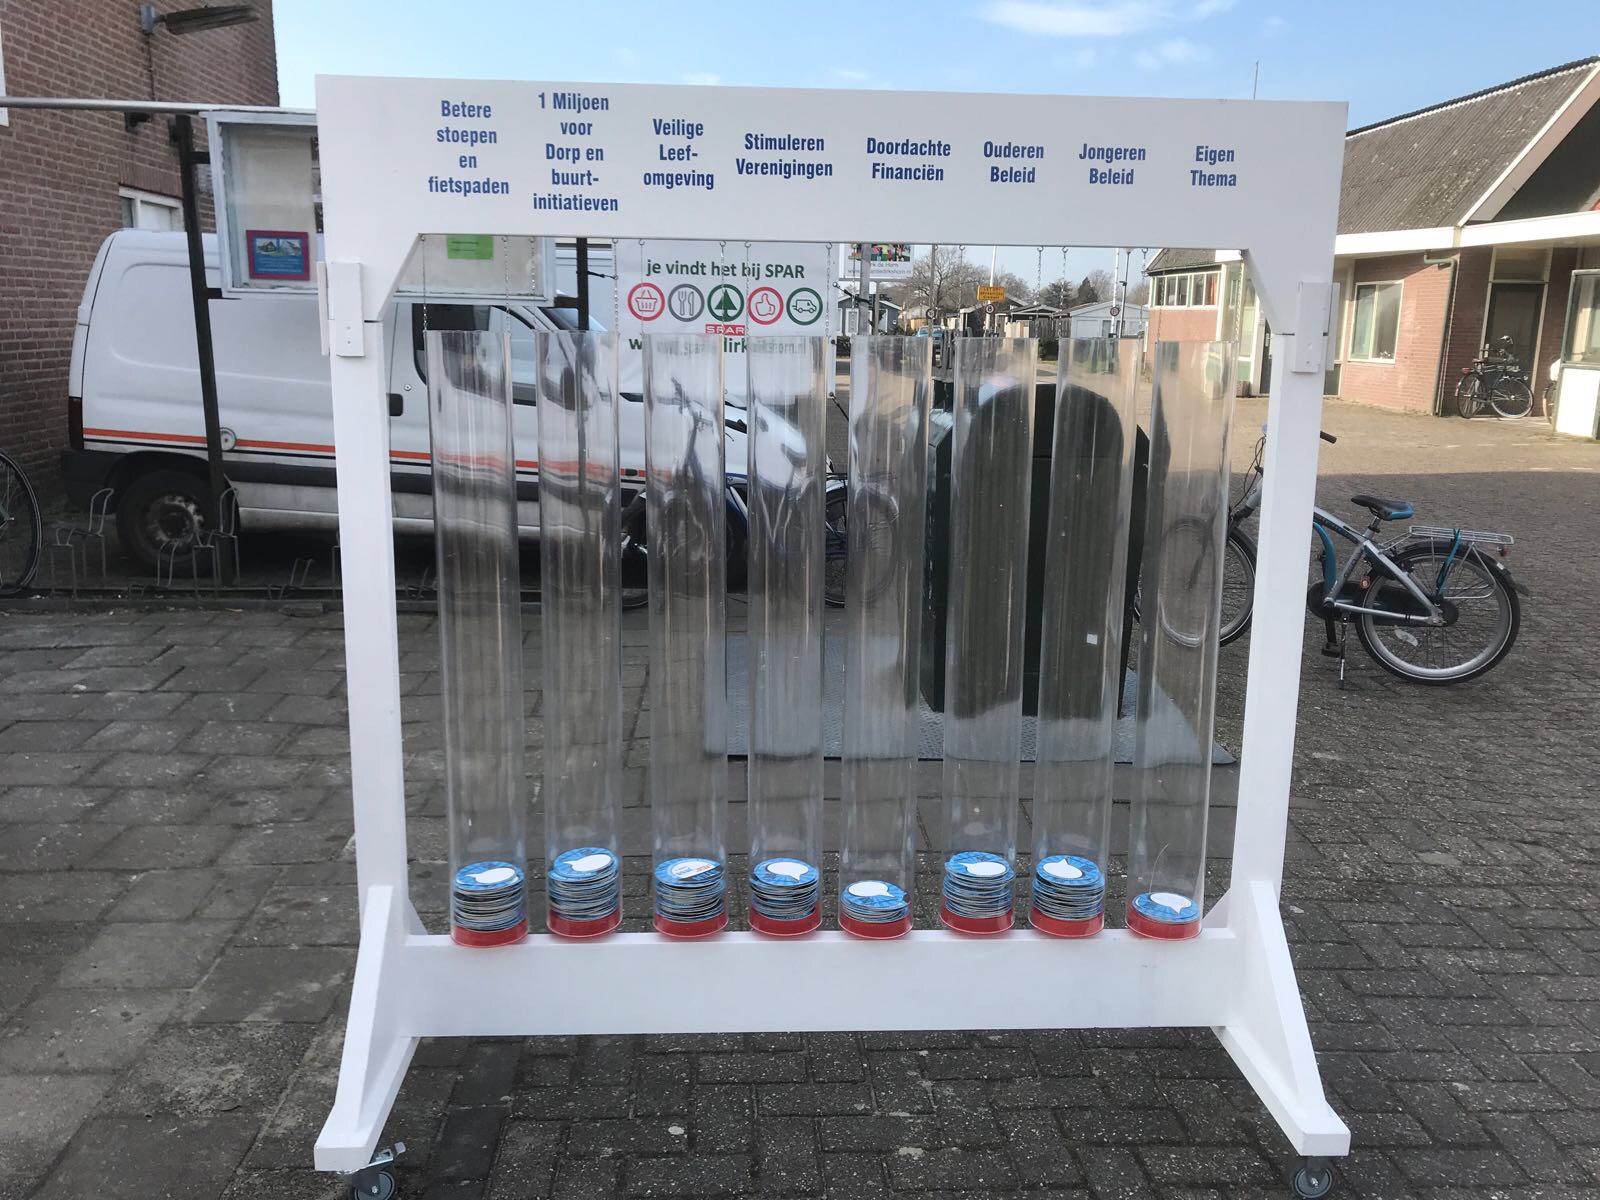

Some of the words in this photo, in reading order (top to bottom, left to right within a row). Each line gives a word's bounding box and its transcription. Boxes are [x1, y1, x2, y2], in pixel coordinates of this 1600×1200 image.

[440, 99, 492, 119] Betere
[537, 91, 546, 110] 1
[552, 92, 609, 114] Miljoen
[436, 126, 498, 148] stoepen
[559, 121, 593, 136] voor
[652, 118, 704, 140] Veilige
[744, 132, 825, 152] Stimuleren
[866, 137, 951, 157] Doordachte
[983, 140, 1045, 159] Ouderen
[458, 155, 477, 169] en
[545, 142, 581, 165] Dorp
[585, 147, 604, 162] en
[659, 143, 699, 162] Leef-
[1078, 143, 1146, 164] Jongeren
[1195, 145, 1235, 166] Eigen
[551, 168, 600, 186] buurt-
[735, 157, 833, 180] Verenigingen
[871, 162, 944, 181] Financiën
[989, 165, 1036, 184] Beleid
[1089, 167, 1135, 185] Beleid
[1189, 169, 1237, 187] Thema
[427, 175, 510, 198] fietspaden
[643, 169, 715, 191] omgeving
[533, 192, 619, 212] initiatieven
[646, 259, 661, 277] je
[665, 260, 707, 276] vindt
[711, 261, 737, 277] het
[741, 262, 761, 280] bij
[765, 264, 805, 279] SPAR
[706, 325, 745, 335] SPAR
